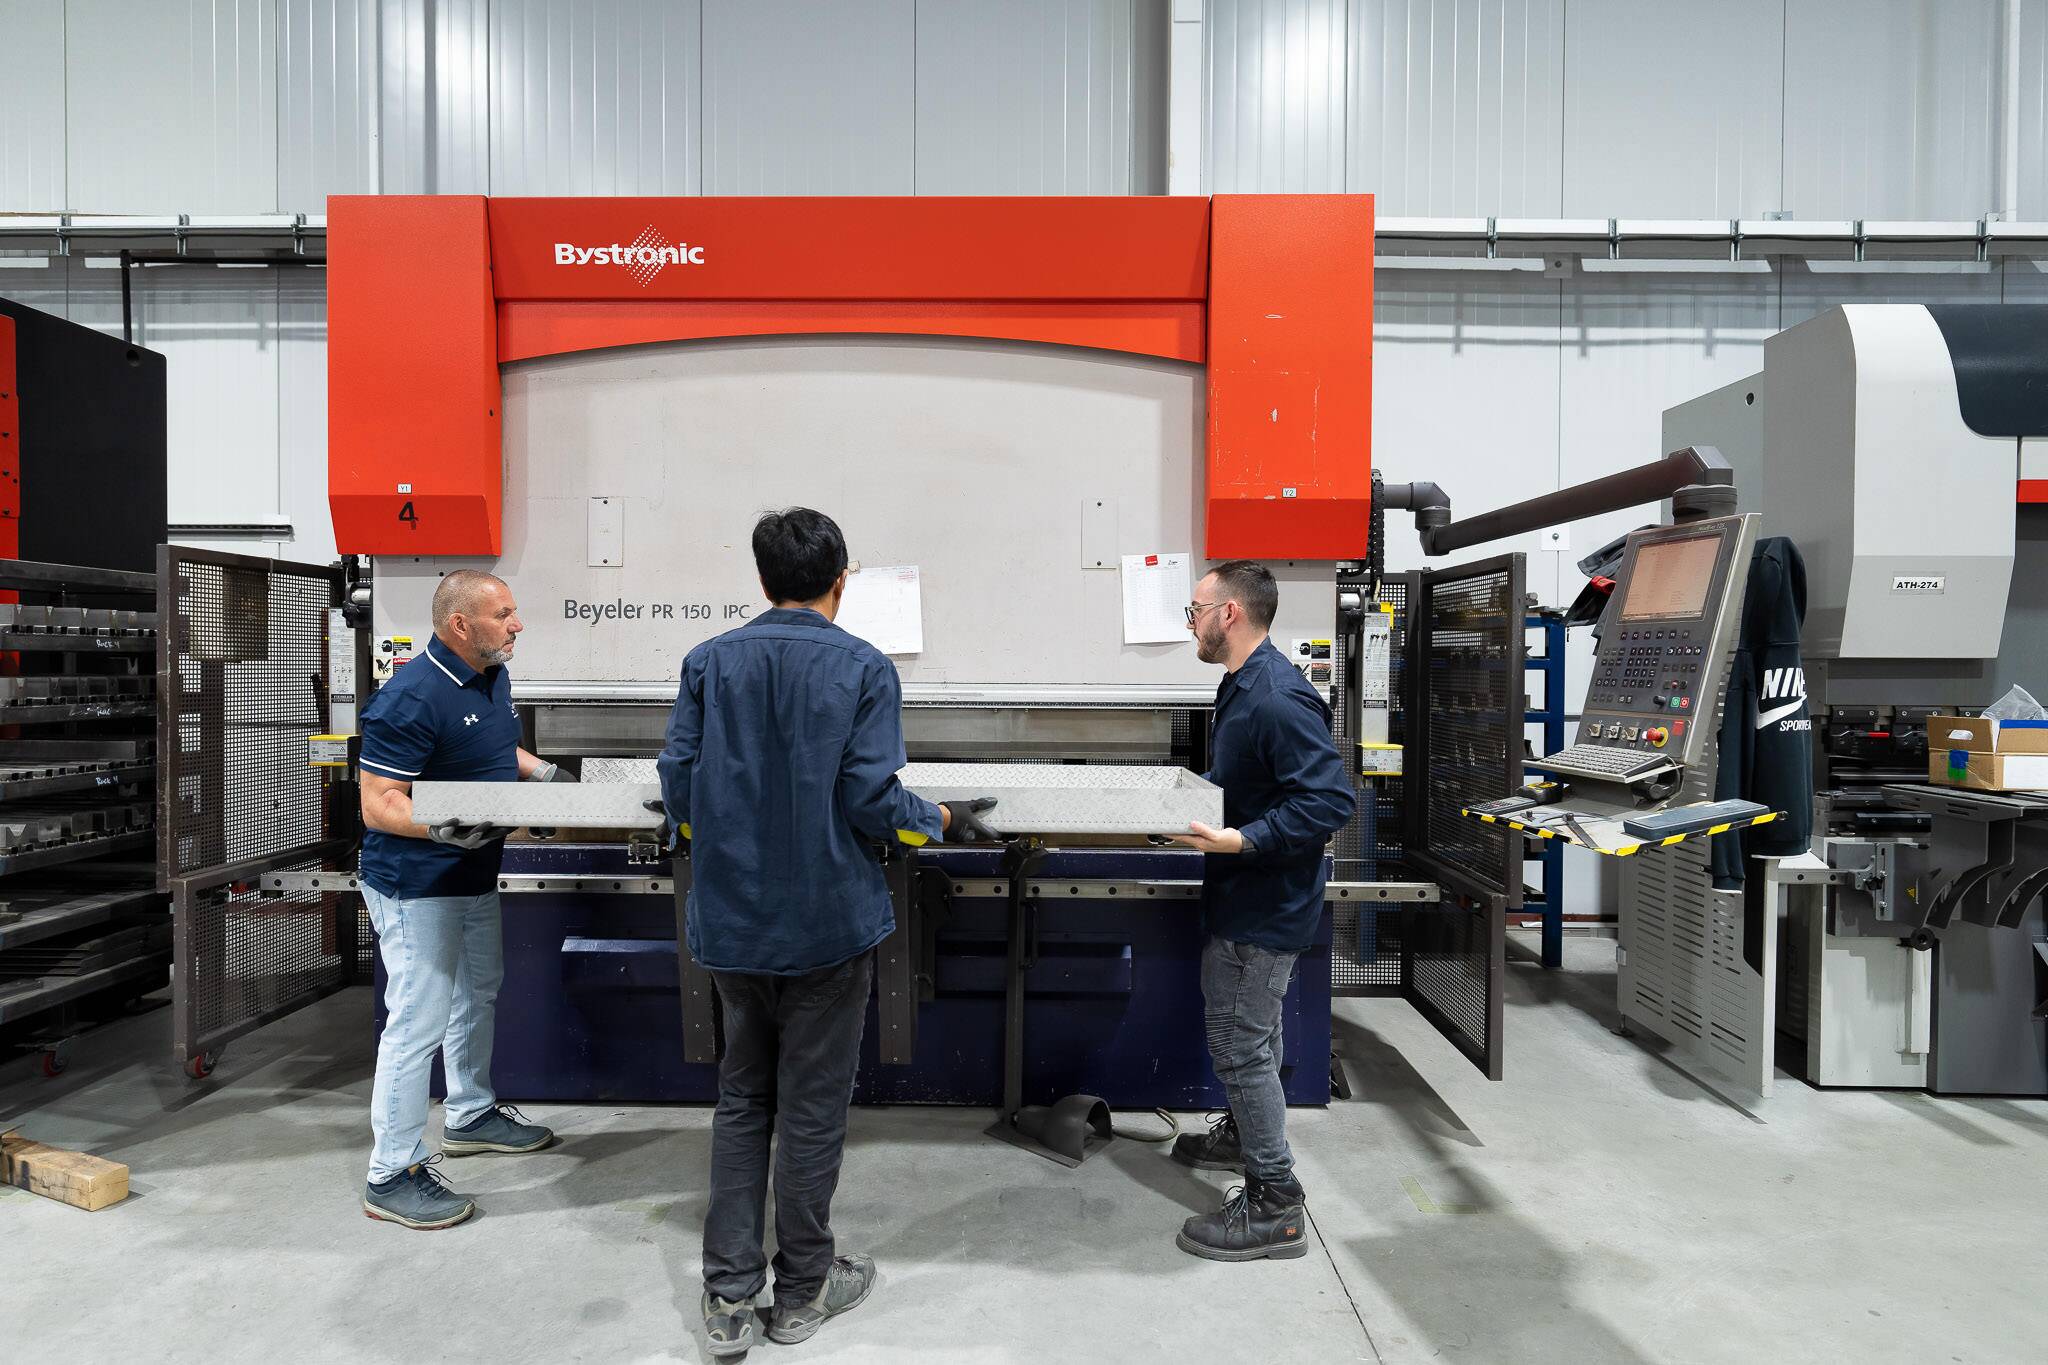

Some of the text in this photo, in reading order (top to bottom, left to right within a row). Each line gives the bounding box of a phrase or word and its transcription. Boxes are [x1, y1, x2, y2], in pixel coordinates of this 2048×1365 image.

[554, 243, 705, 265] Bystronic
[398, 501, 419, 530] 4
[1896, 581, 1938, 589] ATH-274
[564, 598, 750, 625] Beyeler PR 150 IPC
